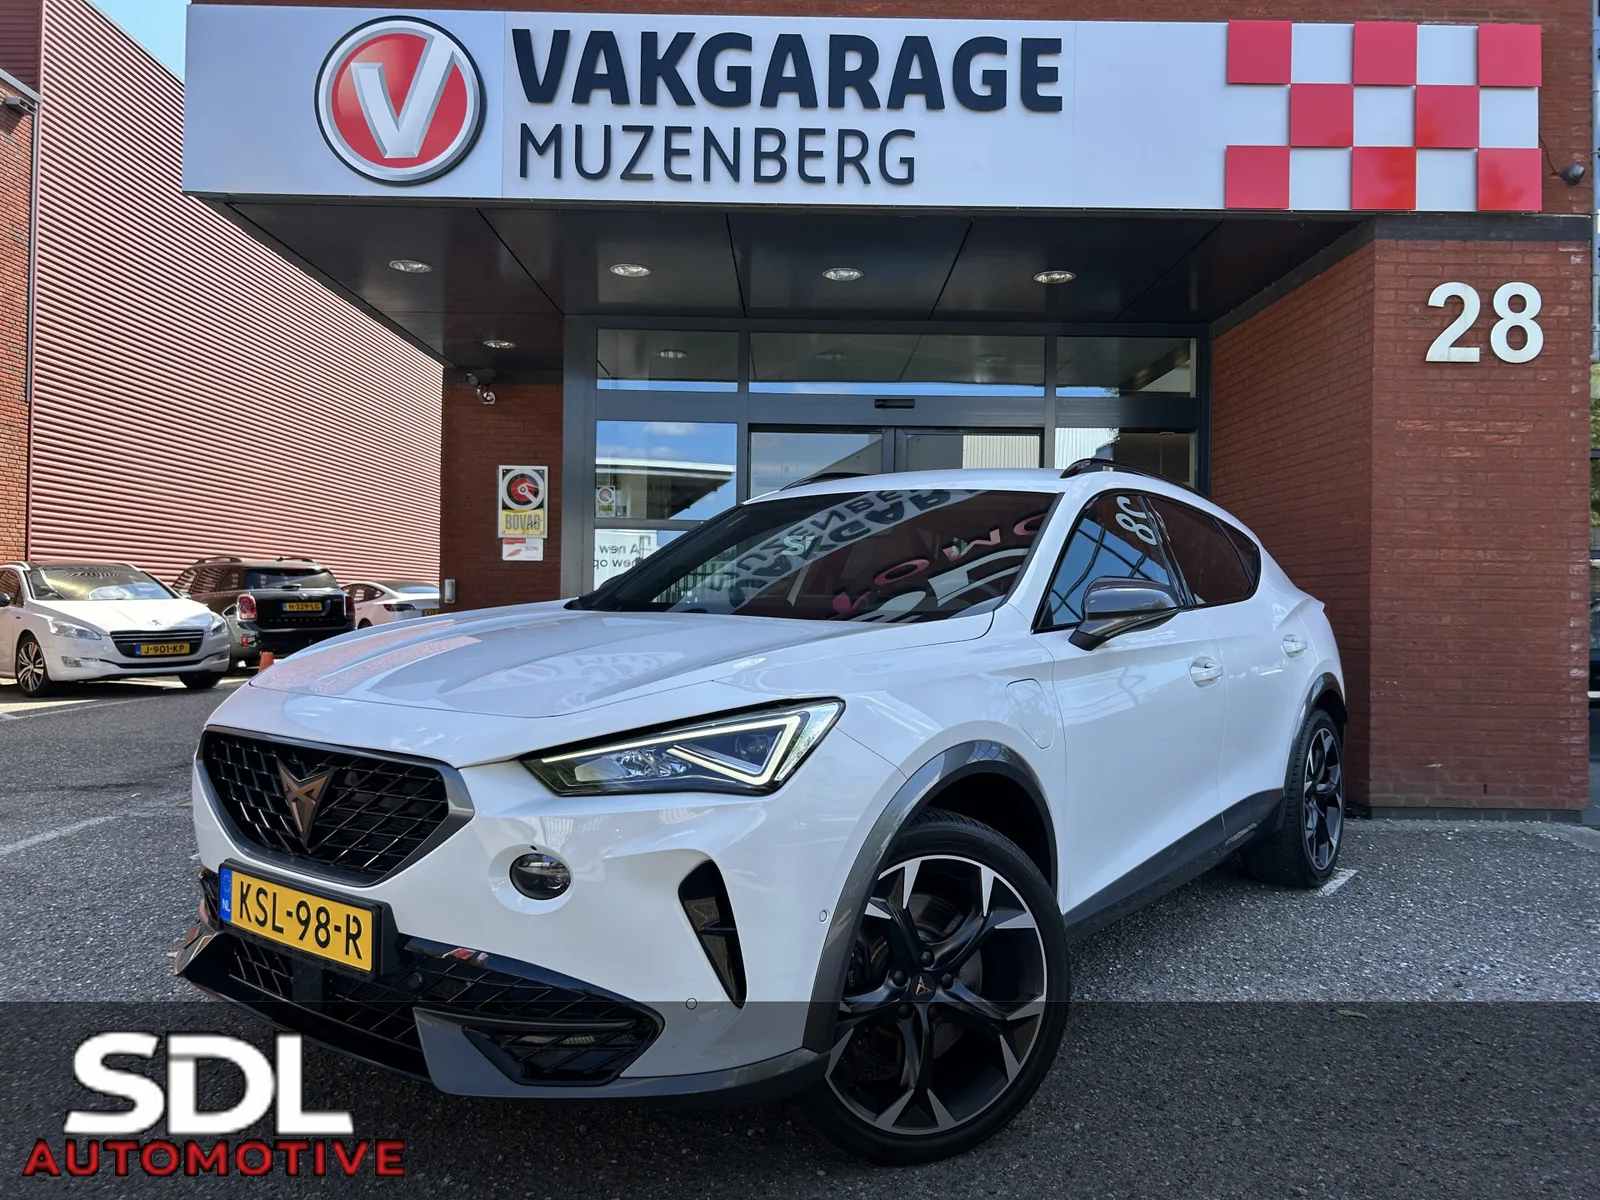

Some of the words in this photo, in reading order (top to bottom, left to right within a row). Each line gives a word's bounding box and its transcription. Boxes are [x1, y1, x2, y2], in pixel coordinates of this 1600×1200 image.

[511, 28, 1063, 112] VAKGARAGE
[519, 122, 916, 186] MUZENBERG
[1425, 281, 1544, 364] 28
[505, 514, 541, 531] BOVAG
[288, 602, 320, 611] H-329-LG
[144, 644, 185, 654] J-901-KP
[221, 897, 231, 913] NL
[239, 880, 363, 960] KSL-98-R
